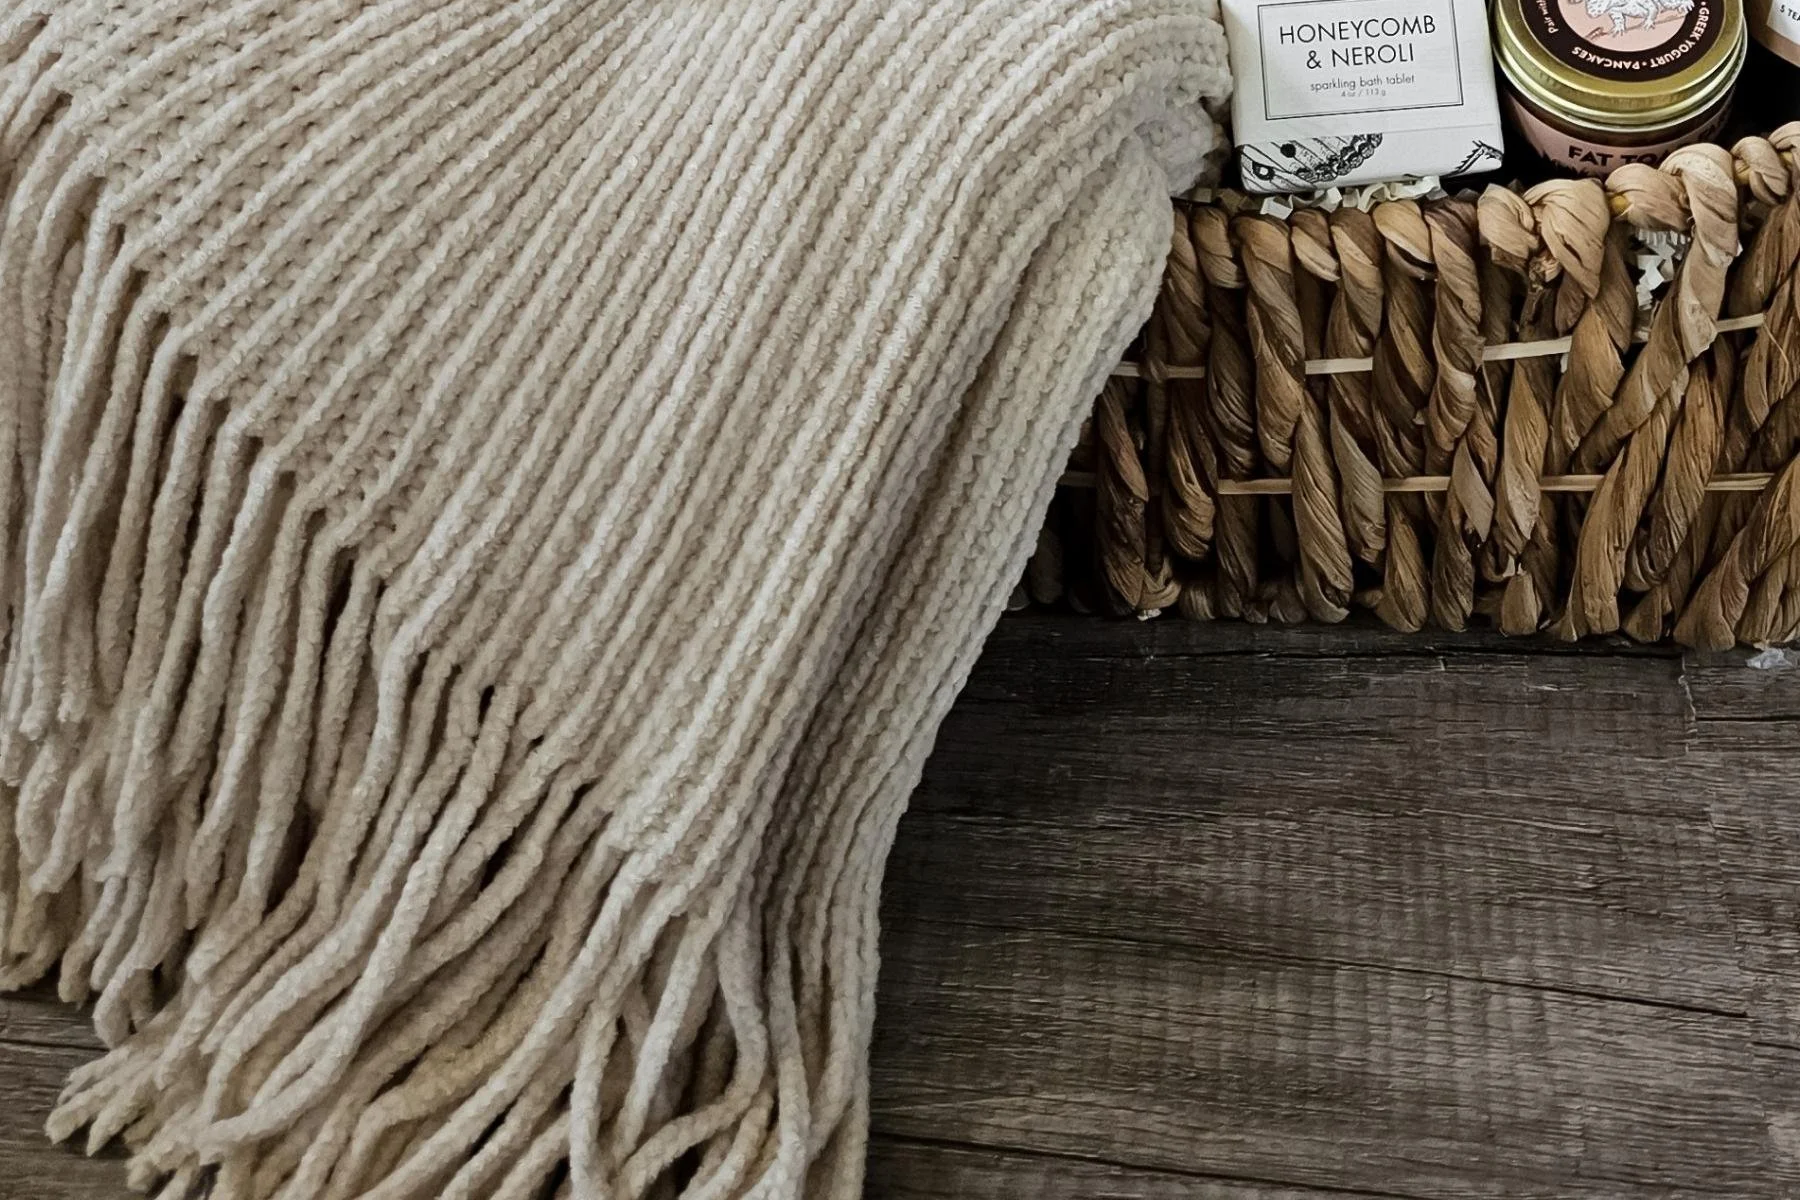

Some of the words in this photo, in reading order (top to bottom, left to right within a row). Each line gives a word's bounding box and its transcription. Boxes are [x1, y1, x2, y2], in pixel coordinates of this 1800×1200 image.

[1280, 15, 1436, 44] HONEYCOMB
[1545, 16, 1559, 34] Pair
[1690, 7, 1710, 40] GREEK
[1306, 50, 1322, 70] &
[1331, 43, 1414, 67] NEROLI
[1572, 46, 1640, 70] PANCAKES
[1650, 40, 1696, 68] YOGURT
[1310, 77, 1356, 92] sparkling
[1360, 74, 1382, 87] bath
[1386, 73, 1415, 85] tablet
[1569, 145, 1613, 166] FAT
